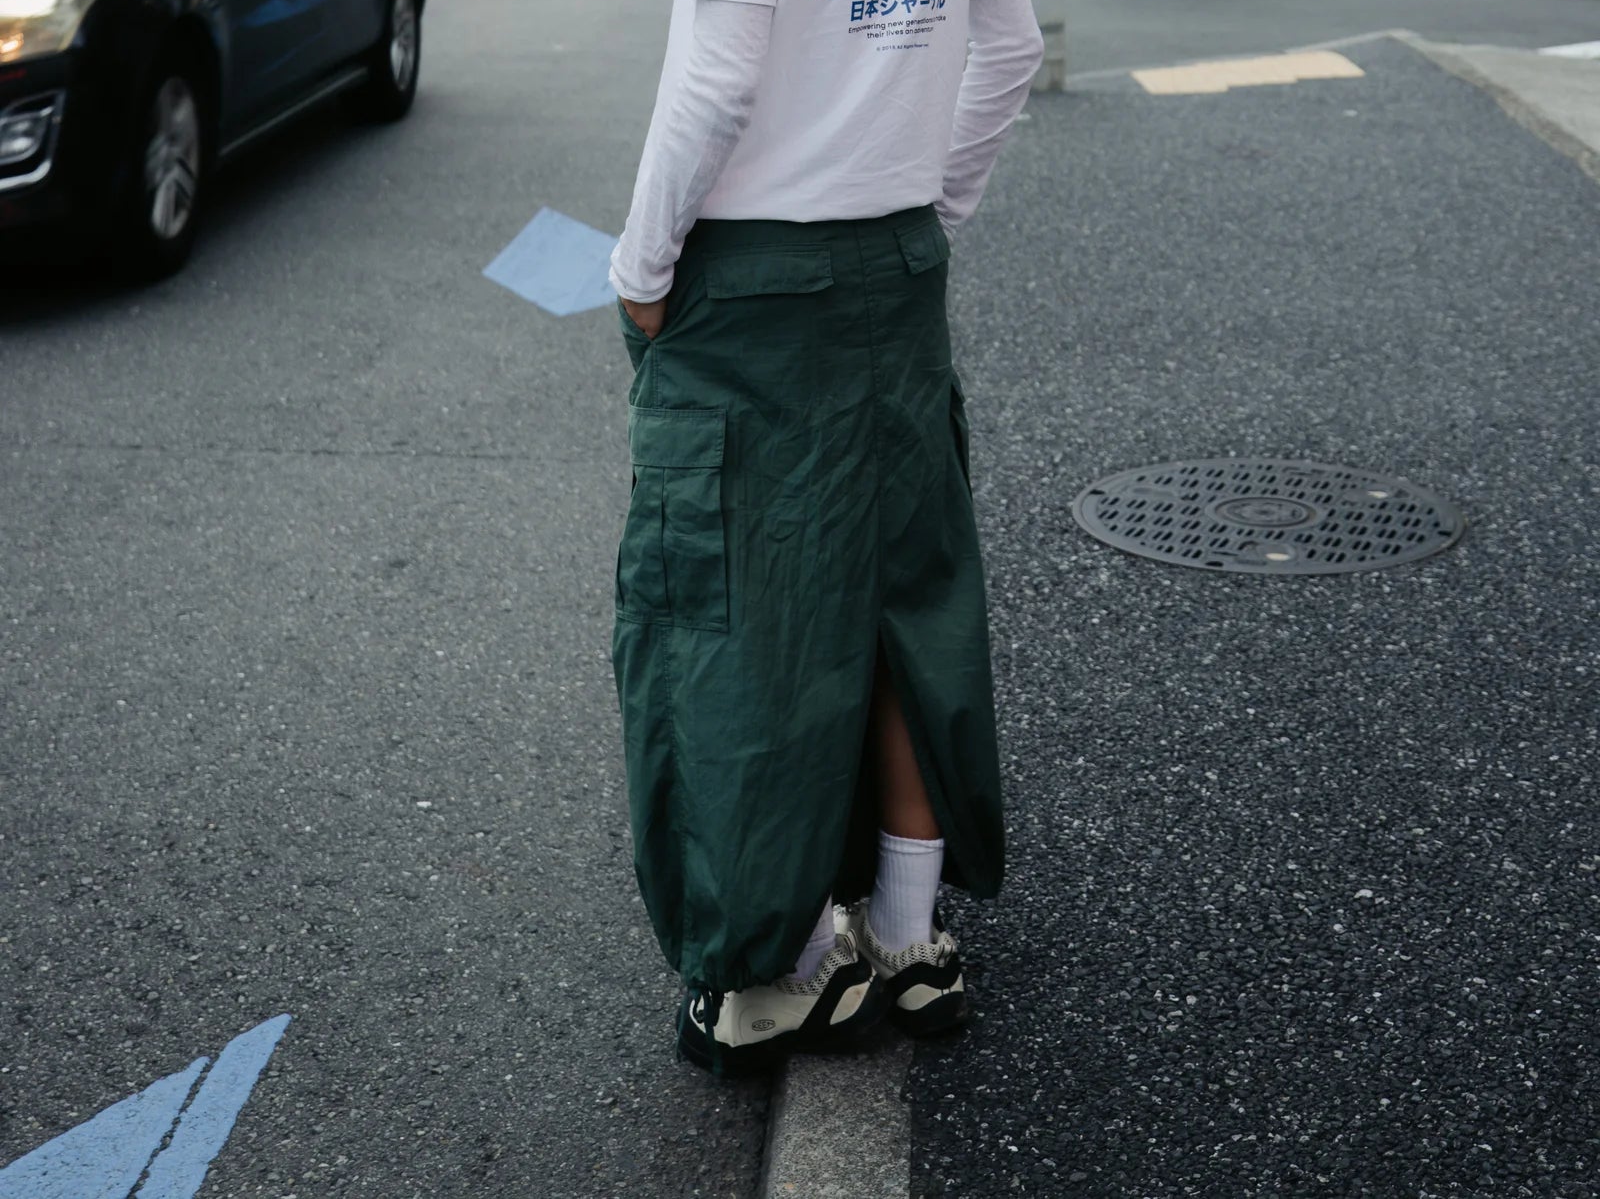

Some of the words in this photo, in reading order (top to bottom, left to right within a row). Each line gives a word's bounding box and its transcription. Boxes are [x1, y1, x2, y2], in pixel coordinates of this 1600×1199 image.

[848, 22, 886, 34] Empowering
[887, 20, 904, 28] new
[867, 30, 885, 39] their
[886, 28, 904, 37] lives
